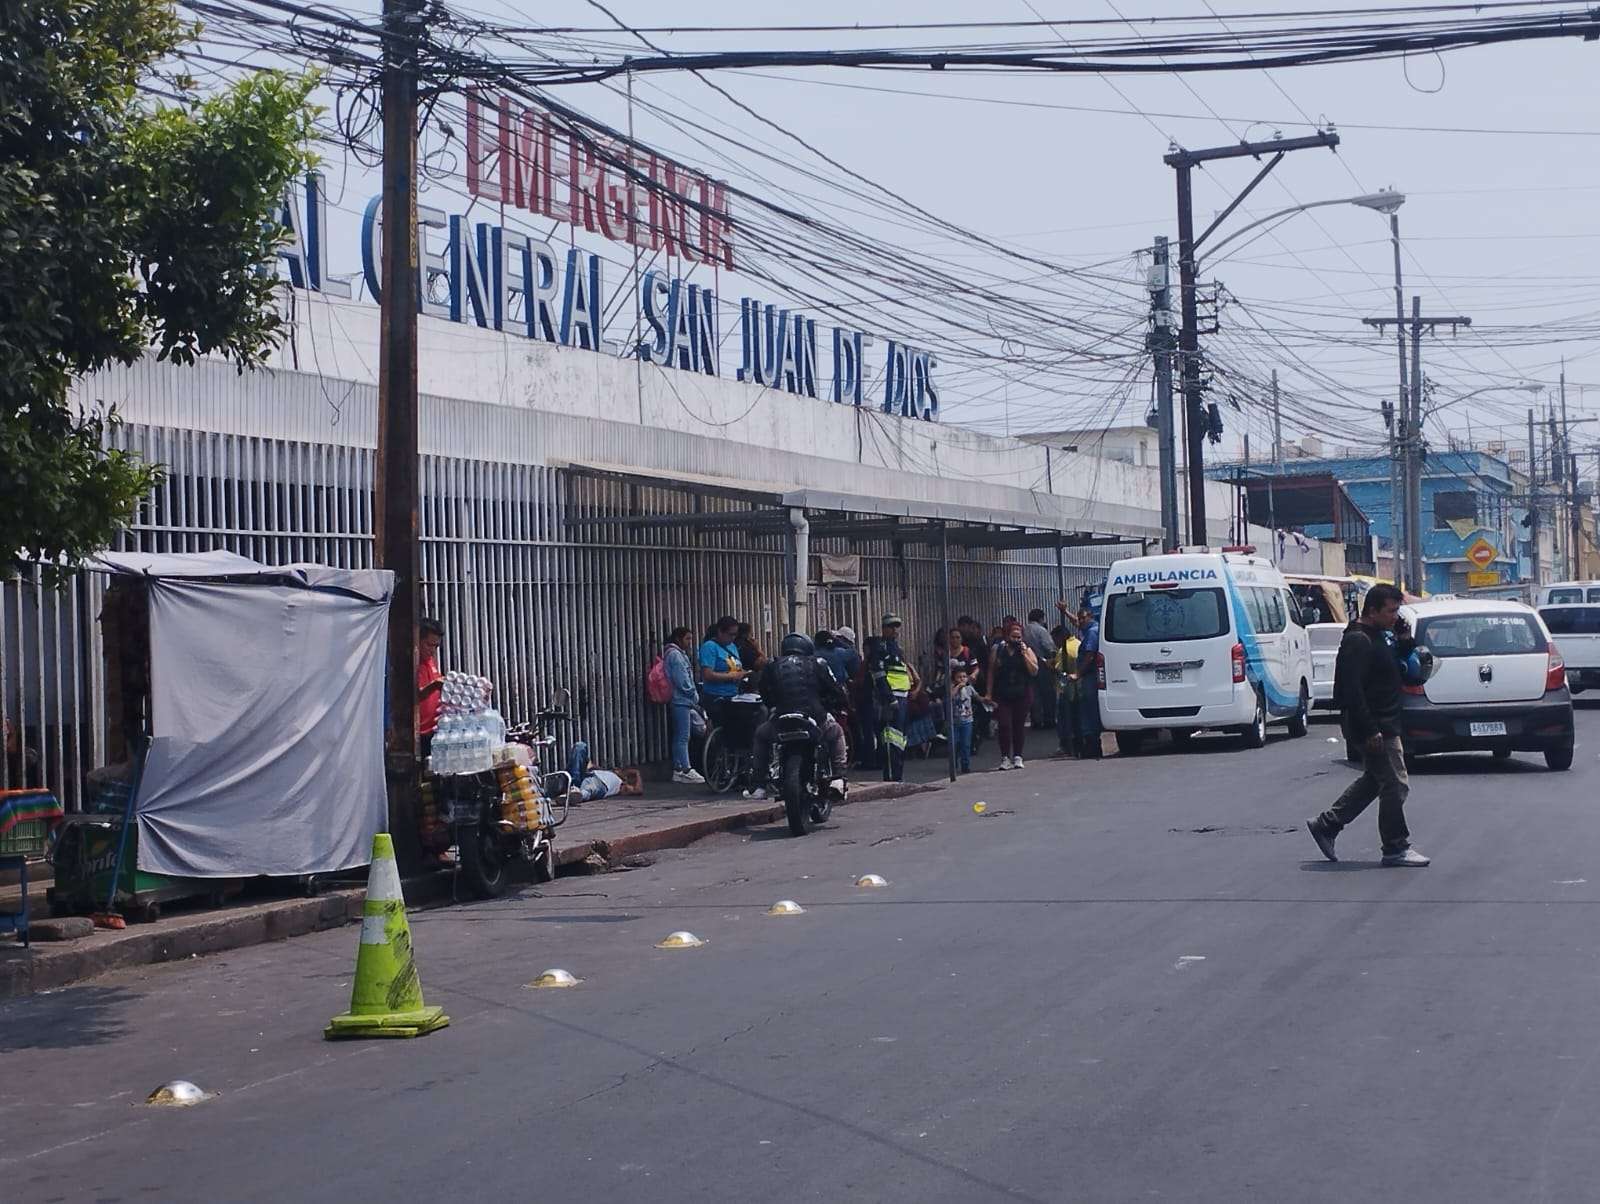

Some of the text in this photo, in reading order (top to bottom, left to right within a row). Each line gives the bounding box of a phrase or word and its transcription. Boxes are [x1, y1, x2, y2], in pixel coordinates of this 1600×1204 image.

[466, 84, 735, 271] EMERGENCIA
[643, 270, 719, 377] SAN
[737, 297, 816, 398] JUAN
[833, 327, 874, 406] DE
[884, 341, 939, 423] DIOS
[1113, 569, 1217, 586] AMBULANCIA
